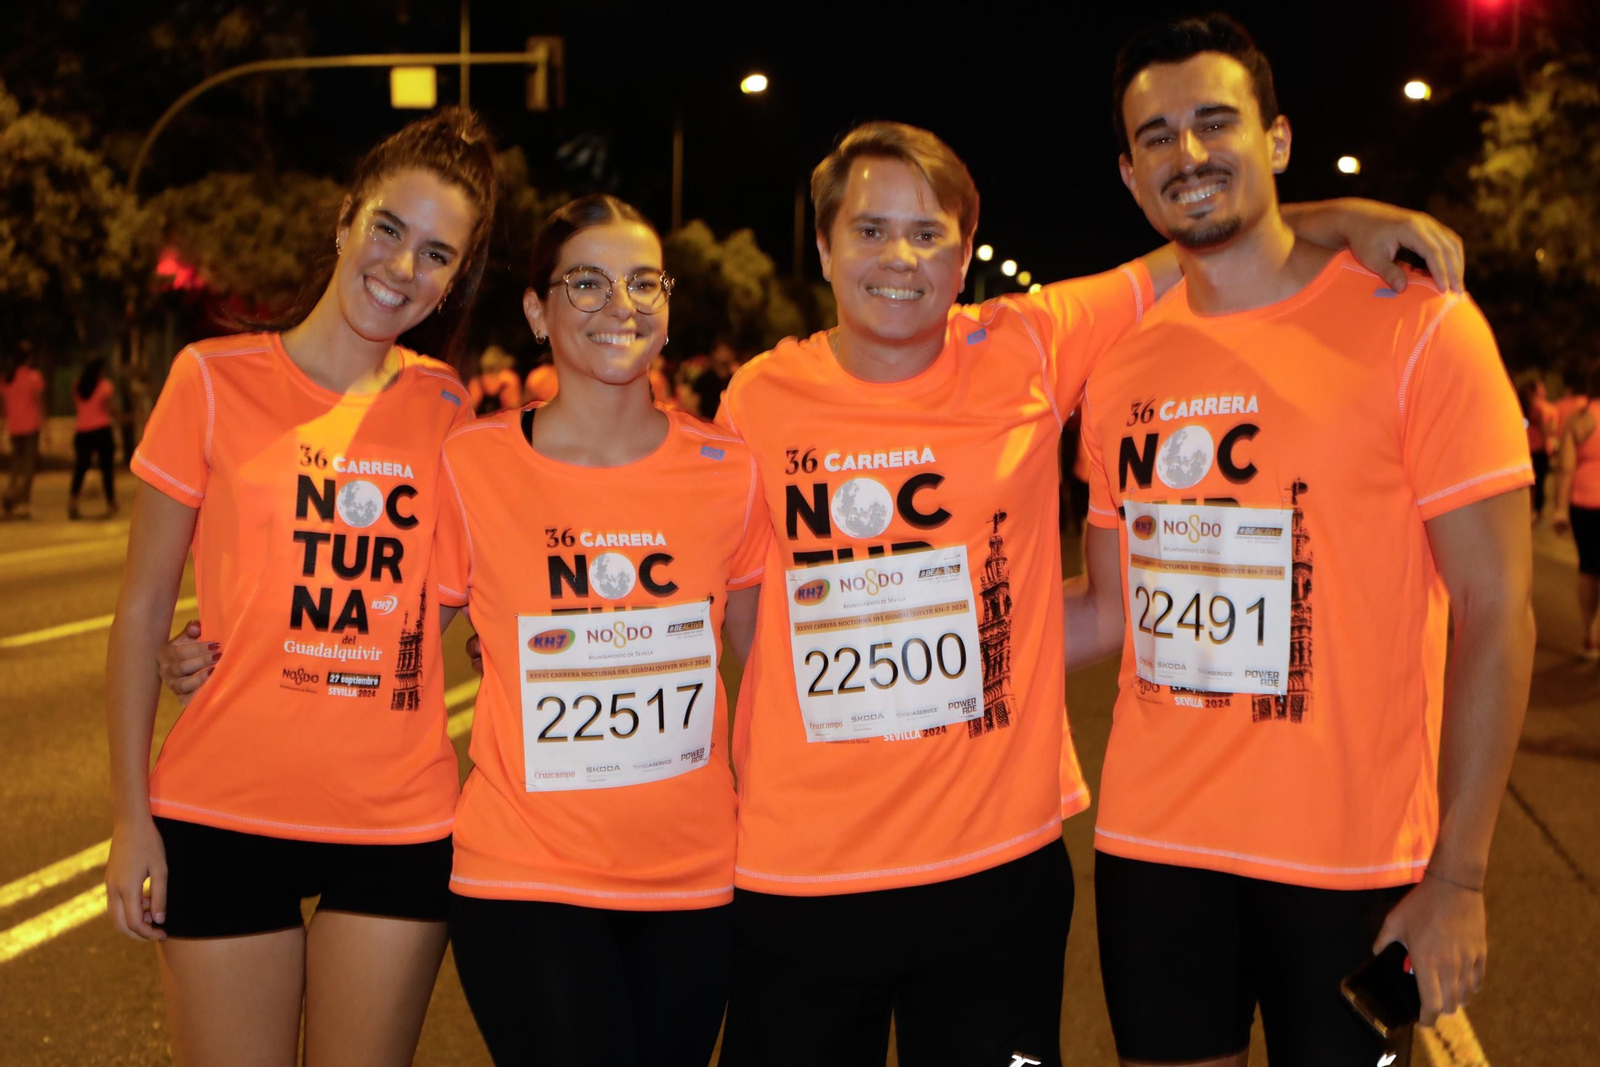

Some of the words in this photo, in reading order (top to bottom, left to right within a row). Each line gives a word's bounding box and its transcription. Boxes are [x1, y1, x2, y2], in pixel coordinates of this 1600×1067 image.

[1126, 398, 1156, 427] 36
[1159, 396, 1259, 421] CARRERA
[300, 444, 328, 470] 36
[332, 457, 414, 479] CARRERA
[785, 447, 818, 475] 36
[824, 447, 936, 472] CARRERA
[545, 527, 576, 548] 36
[579, 531, 667, 547] CARRERA
[293, 530, 403, 584] TUR
[290, 585, 369, 635] NA
[1135, 586, 1266, 646] 22491
[814, 622, 837, 630] CARRERA
[839, 618, 872, 627] NOCTURNA
[341, 636, 356, 645] del
[283, 640, 383, 662] Guadalquivir
[631, 663, 678, 673] GUADALQUIVIR
[804, 632, 967, 697] 22500
[329, 674, 340, 683] 27
[341, 675, 379, 686] septiembre
[1245, 670, 1279, 679] POWER
[328, 687, 357, 698] SEVILLA
[358, 689, 376, 698] 2024
[948, 697, 977, 710] POWER
[1174, 697, 1203, 709] SEVILLA
[1205, 699, 1231, 709] 2024
[536, 682, 704, 743] 22517
[809, 721, 843, 730] Cruzcampo
[883, 730, 922, 742] SEVILLA
[923, 725, 947, 738] 2024
[681, 747, 705, 761] POWER
[535, 771, 575, 779] Cruzcampo
